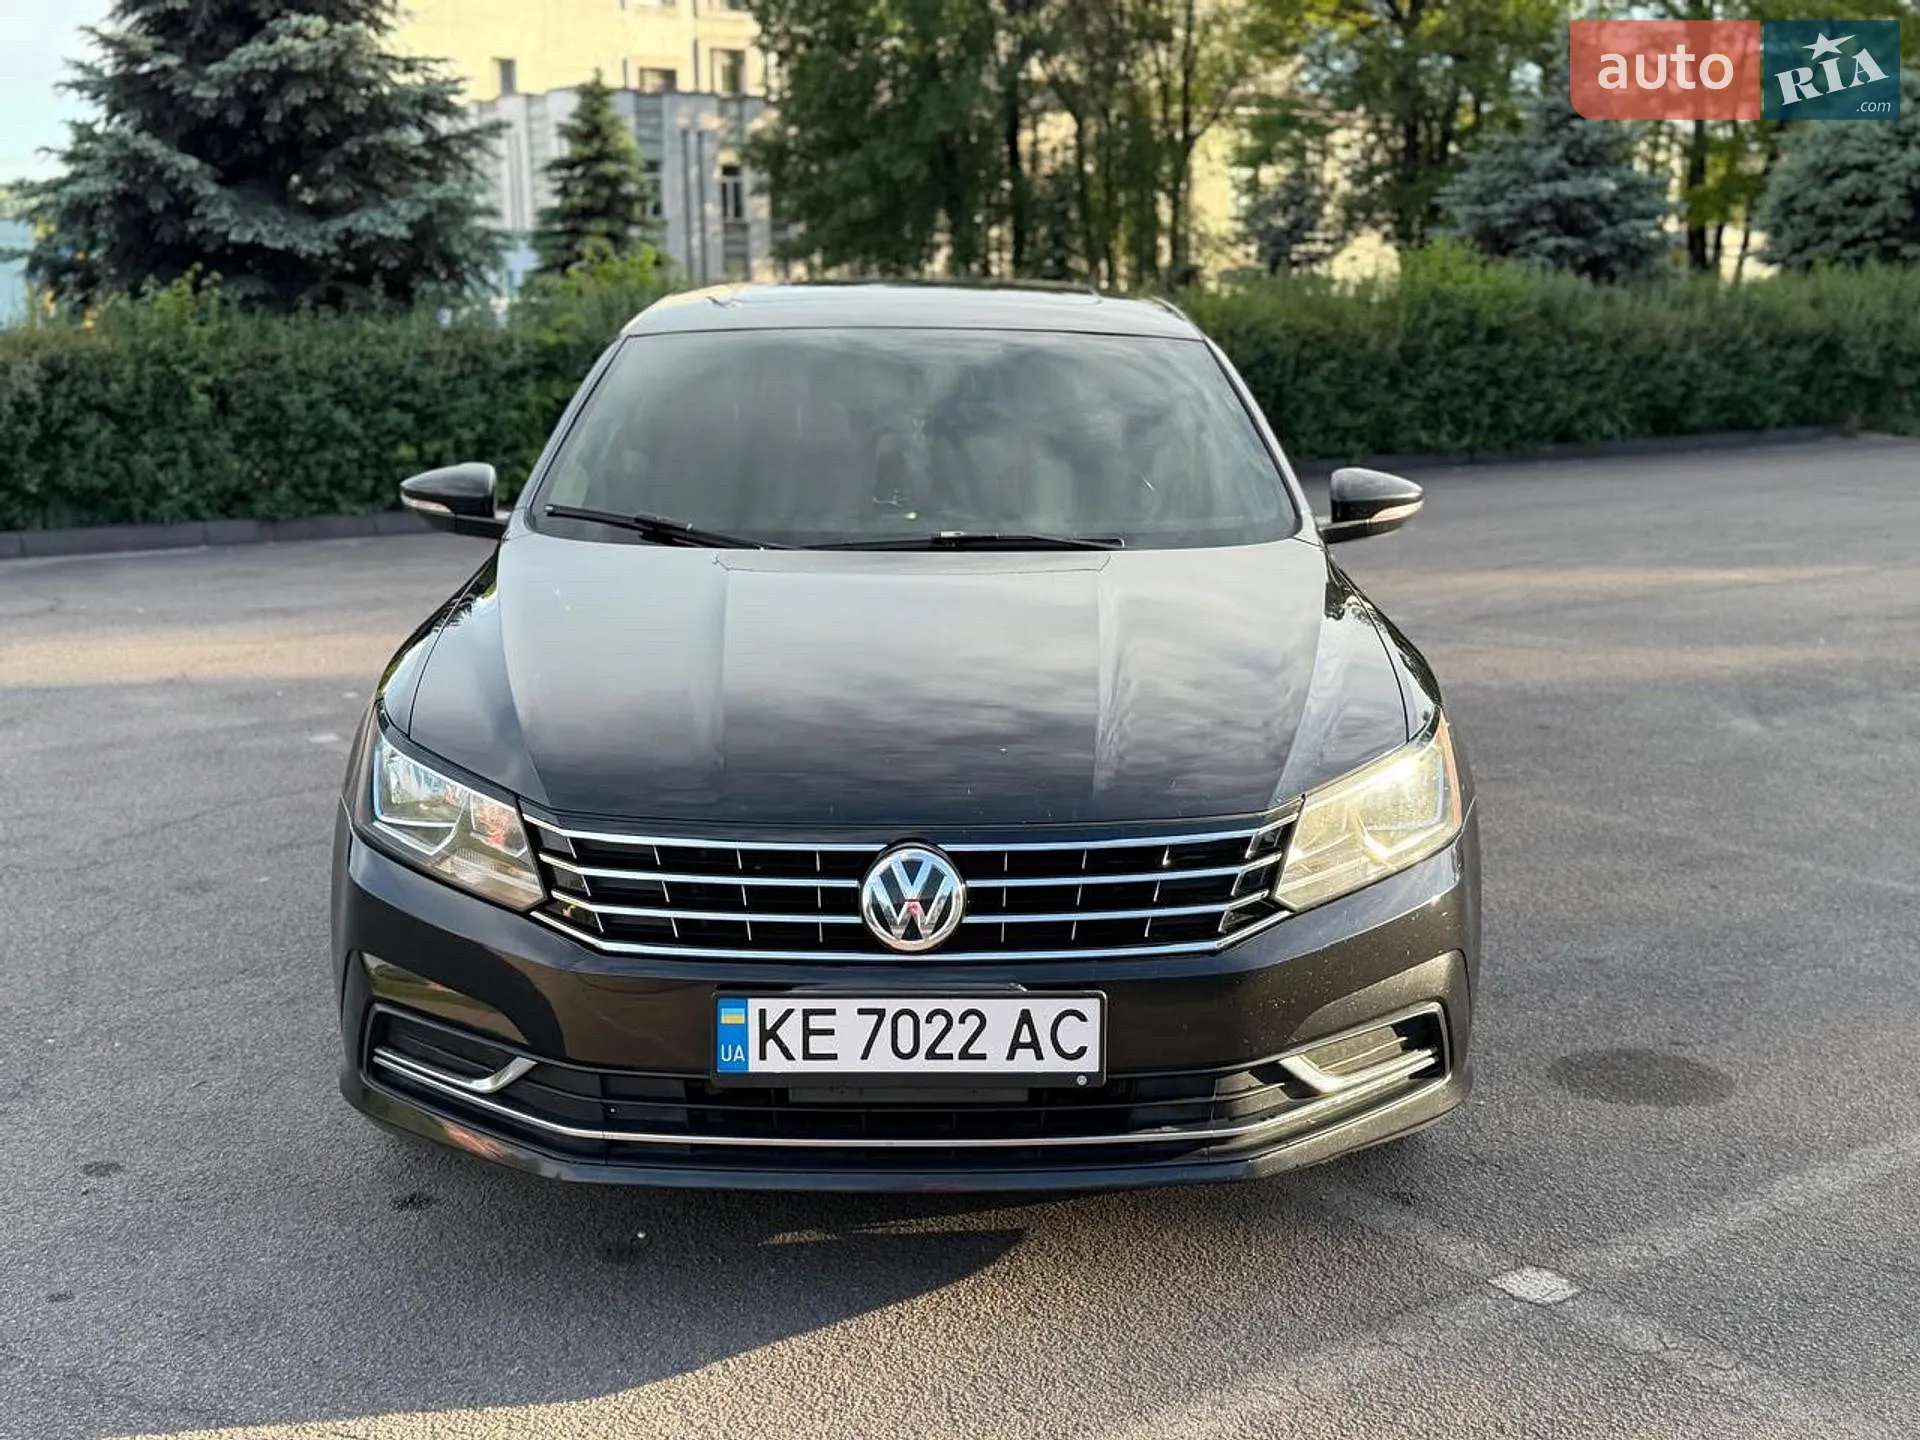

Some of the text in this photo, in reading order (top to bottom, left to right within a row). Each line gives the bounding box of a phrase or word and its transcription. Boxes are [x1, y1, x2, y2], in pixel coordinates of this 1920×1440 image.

[758, 1008, 1089, 1061] KE 7022 AC
[720, 1044, 745, 1062] UA
